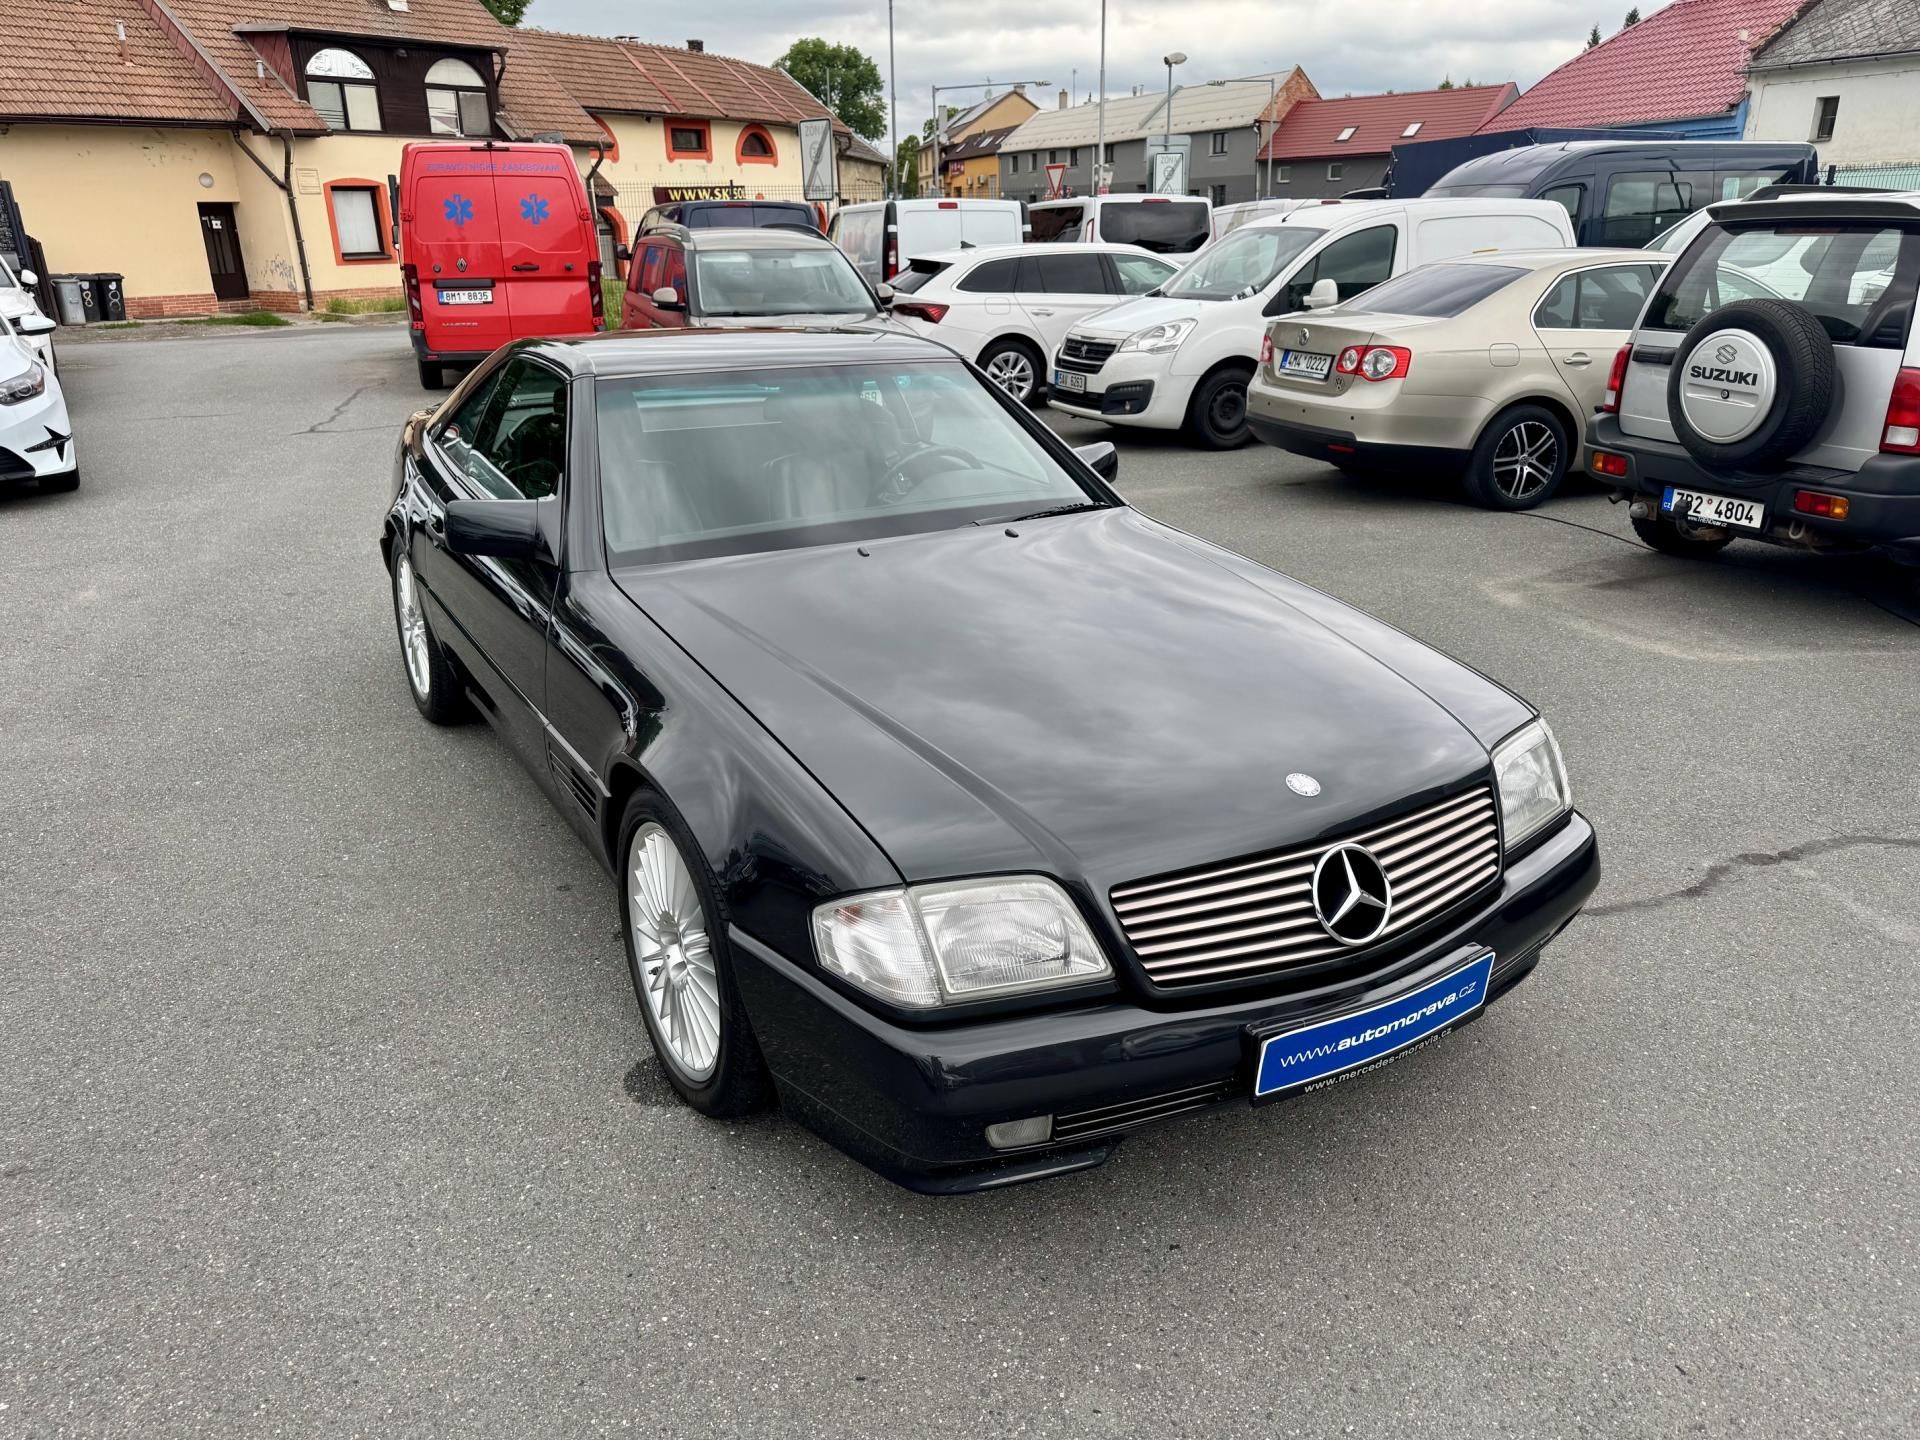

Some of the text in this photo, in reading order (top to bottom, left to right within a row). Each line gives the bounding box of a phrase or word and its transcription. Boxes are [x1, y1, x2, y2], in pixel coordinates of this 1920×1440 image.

[1287, 352, 1327, 372] 4M4 0222
[1690, 365, 1758, 386] SUZUKI
[1714, 499, 1755, 524] 4804
[1280, 981, 1477, 1068] www.automorava.cz
[1304, 1028, 1453, 1093] www.mercedes-moravia.cz
